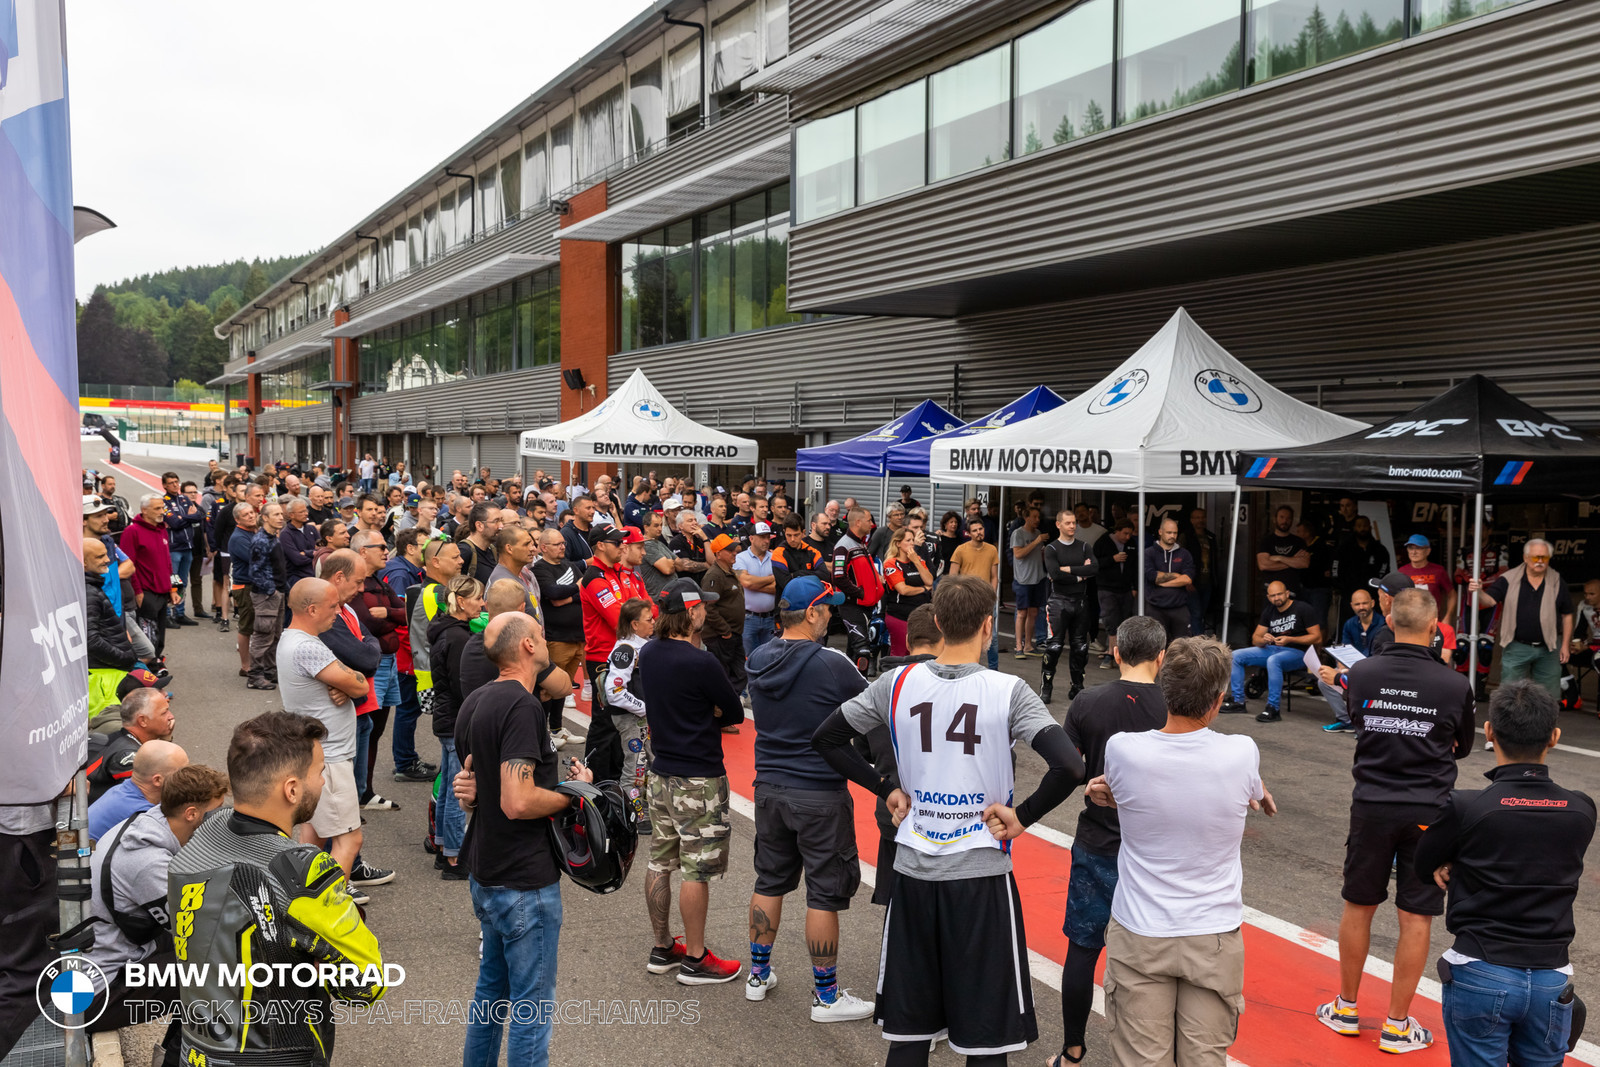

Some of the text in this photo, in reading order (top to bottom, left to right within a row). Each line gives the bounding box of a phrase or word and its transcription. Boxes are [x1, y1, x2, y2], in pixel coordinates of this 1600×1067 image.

[1199, 371, 1240, 386] BMW
[1364, 418, 1470, 440] BMC
[1496, 418, 1584, 442] BMC
[524, 437, 566, 453] BMW MOTORRAD
[593, 441, 739, 458] BMW MOTORRAD
[949, 448, 1113, 475] BMW MOTORRAD
[1388, 465, 1462, 479] bmc-moto.com
[614, 651, 630, 663] 74
[1400, 690, 1418, 698] RIDE
[1383, 701, 1437, 715] Motorsport
[909, 701, 982, 756] 14
[1364, 726, 1427, 738] RACING TEAM
[914, 789, 985, 806] TRACKDAYS
[1500, 797, 1568, 808] alpinestars
[918, 809, 936, 818] BMW
[926, 823, 984, 841] MICHELIN
